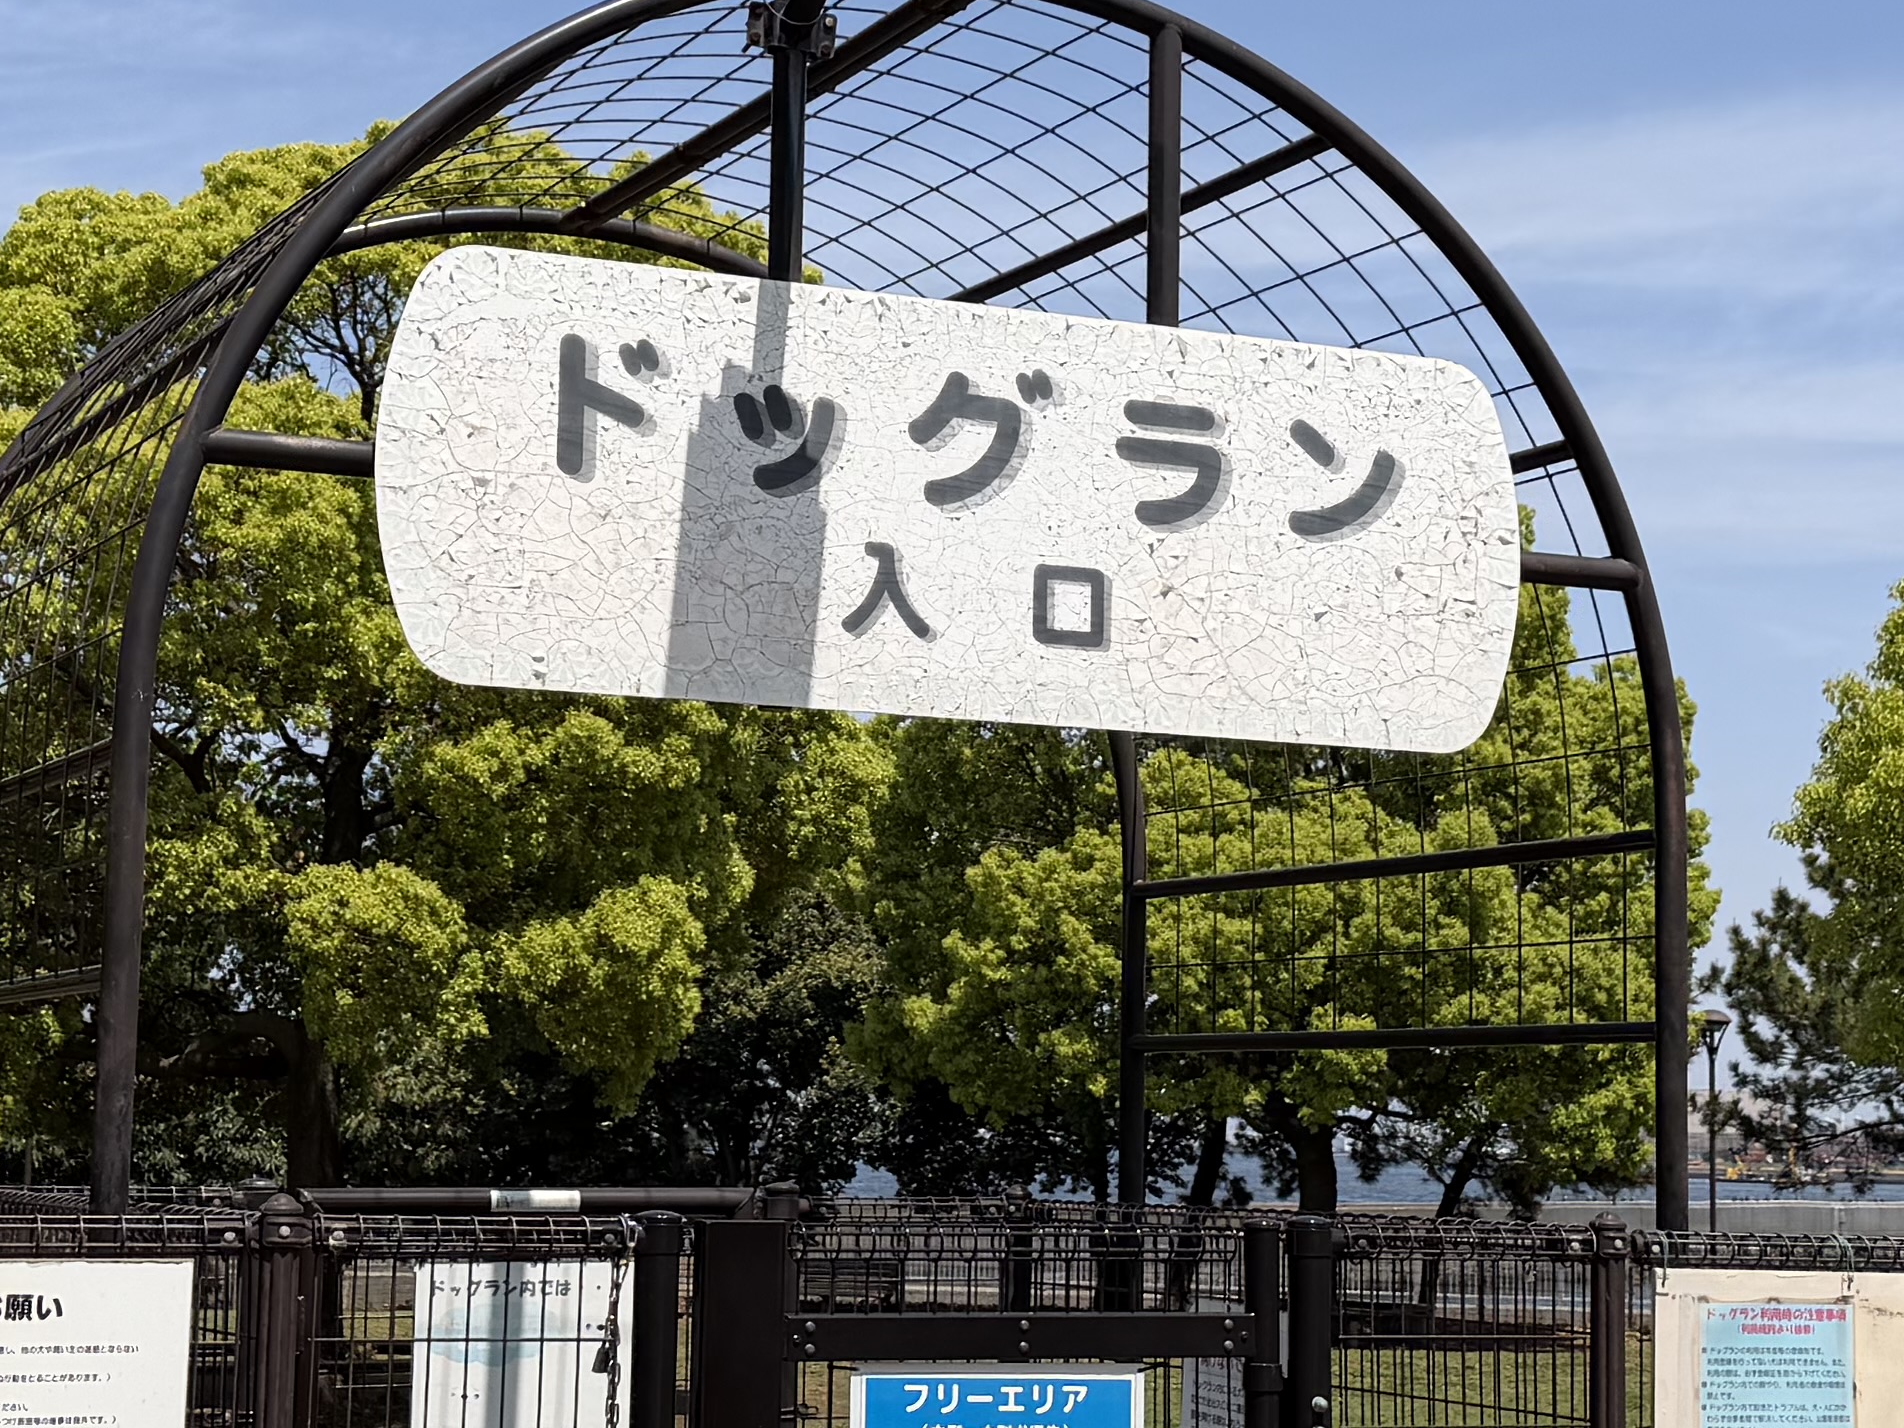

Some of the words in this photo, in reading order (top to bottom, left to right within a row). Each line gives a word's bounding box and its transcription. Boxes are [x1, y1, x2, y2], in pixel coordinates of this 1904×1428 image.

[554, 330, 1405, 542] ドッグラン
[840, 540, 1110, 650] 入口
[903, 1383, 1089, 1415] フリーエリア
